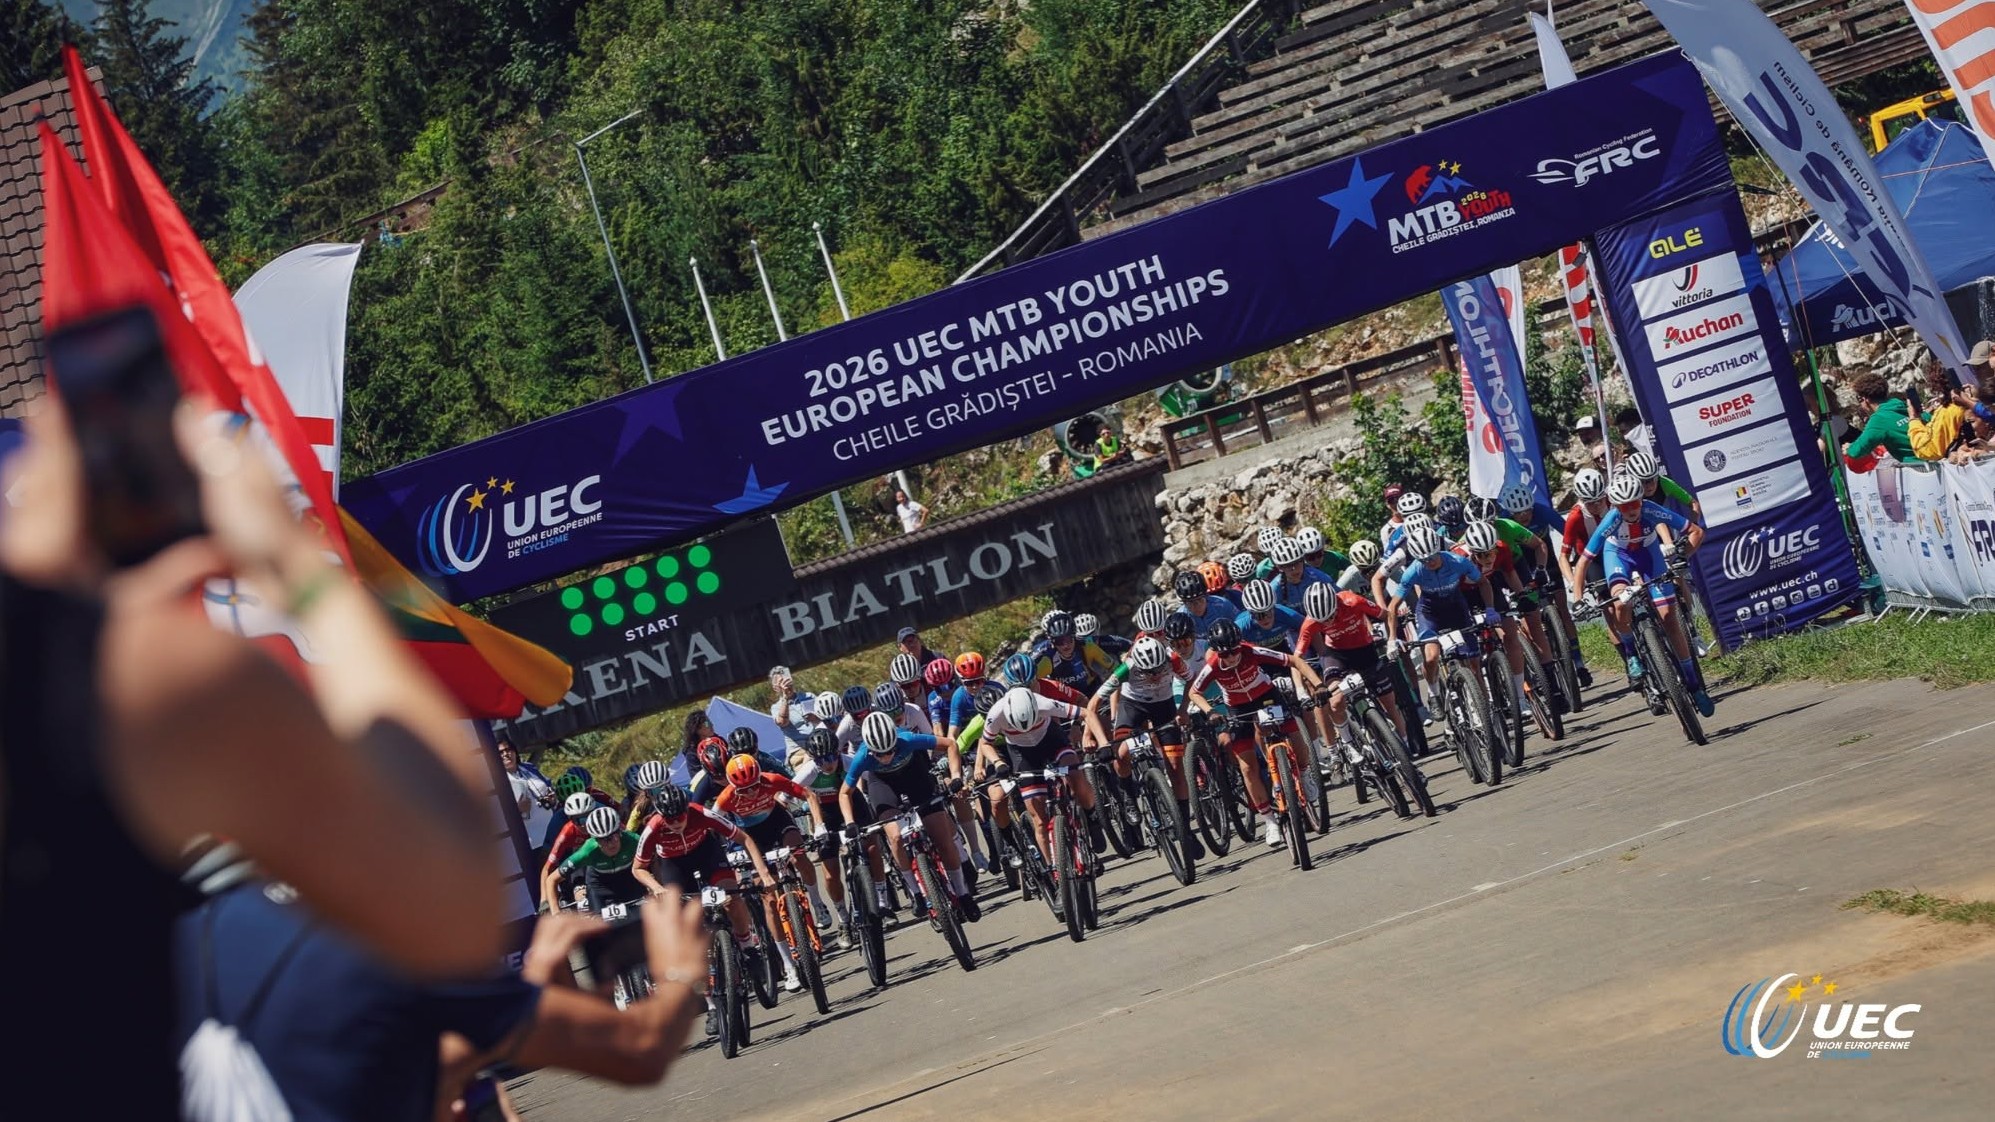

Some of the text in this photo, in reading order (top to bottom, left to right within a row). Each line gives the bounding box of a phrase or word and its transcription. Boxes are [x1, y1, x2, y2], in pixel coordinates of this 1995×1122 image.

[1602, 139, 1624, 150] Cycling
[1623, 127, 1653, 142] Federation
[1574, 135, 1660, 187] FRC
[1461, 191, 1487, 206] 2026
[1388, 189, 1512, 246] MTB YOUTH
[1392, 236, 1426, 254] CHEILE
[1672, 287, 1714, 308] vittoria
[804, 254, 1166, 398] 2026 UEC MTB YOUTH
[1663, 312, 1744, 350] Auchan
[761, 268, 1230, 446] EUROPEAN CHAMPIONSHIPS
[1688, 351, 1759, 382] DECATHLON
[833, 415, 923, 461] CHEILE
[926, 370, 1057, 431] GRĂDIȘTEI
[1078, 322, 1203, 380] ROMANIA
[1699, 393, 1755, 420] SUPER
[1709, 408, 1752, 428] FOUNDATION
[503, 474, 602, 537] UEC
[507, 512, 603, 550] UNION EUROPÉENNE
[1768, 524, 1819, 558] UEC
[508, 533, 569, 559] DE CYCLISME
[771, 522, 1058, 643] BIATLON
[1749, 570, 1818, 600] www.uec.ch
[625, 614, 679, 642] START
[1347, 677, 1357, 690] 6
[1267, 707, 1275, 720] 5
[608, 905, 621, 917] 16
[710, 890, 718, 904] 9
